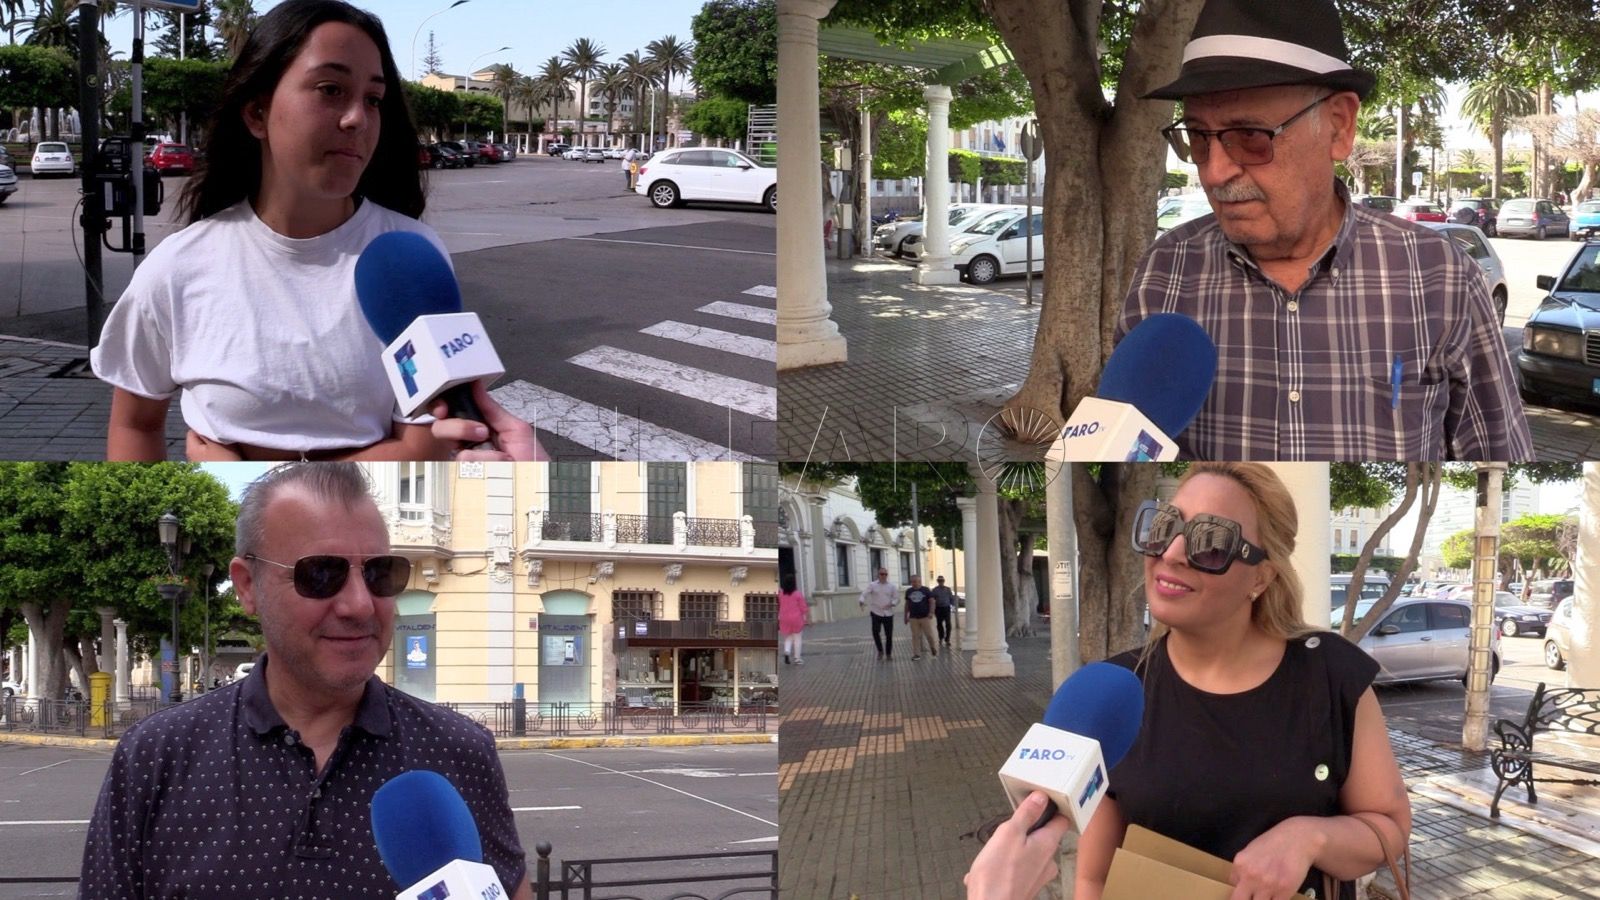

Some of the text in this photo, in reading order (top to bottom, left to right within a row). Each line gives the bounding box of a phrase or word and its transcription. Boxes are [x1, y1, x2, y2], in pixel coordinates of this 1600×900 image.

[440, 333, 474, 358] FARO
[1063, 421, 1099, 440] FARO
[1019, 748, 1066, 761] FARO
